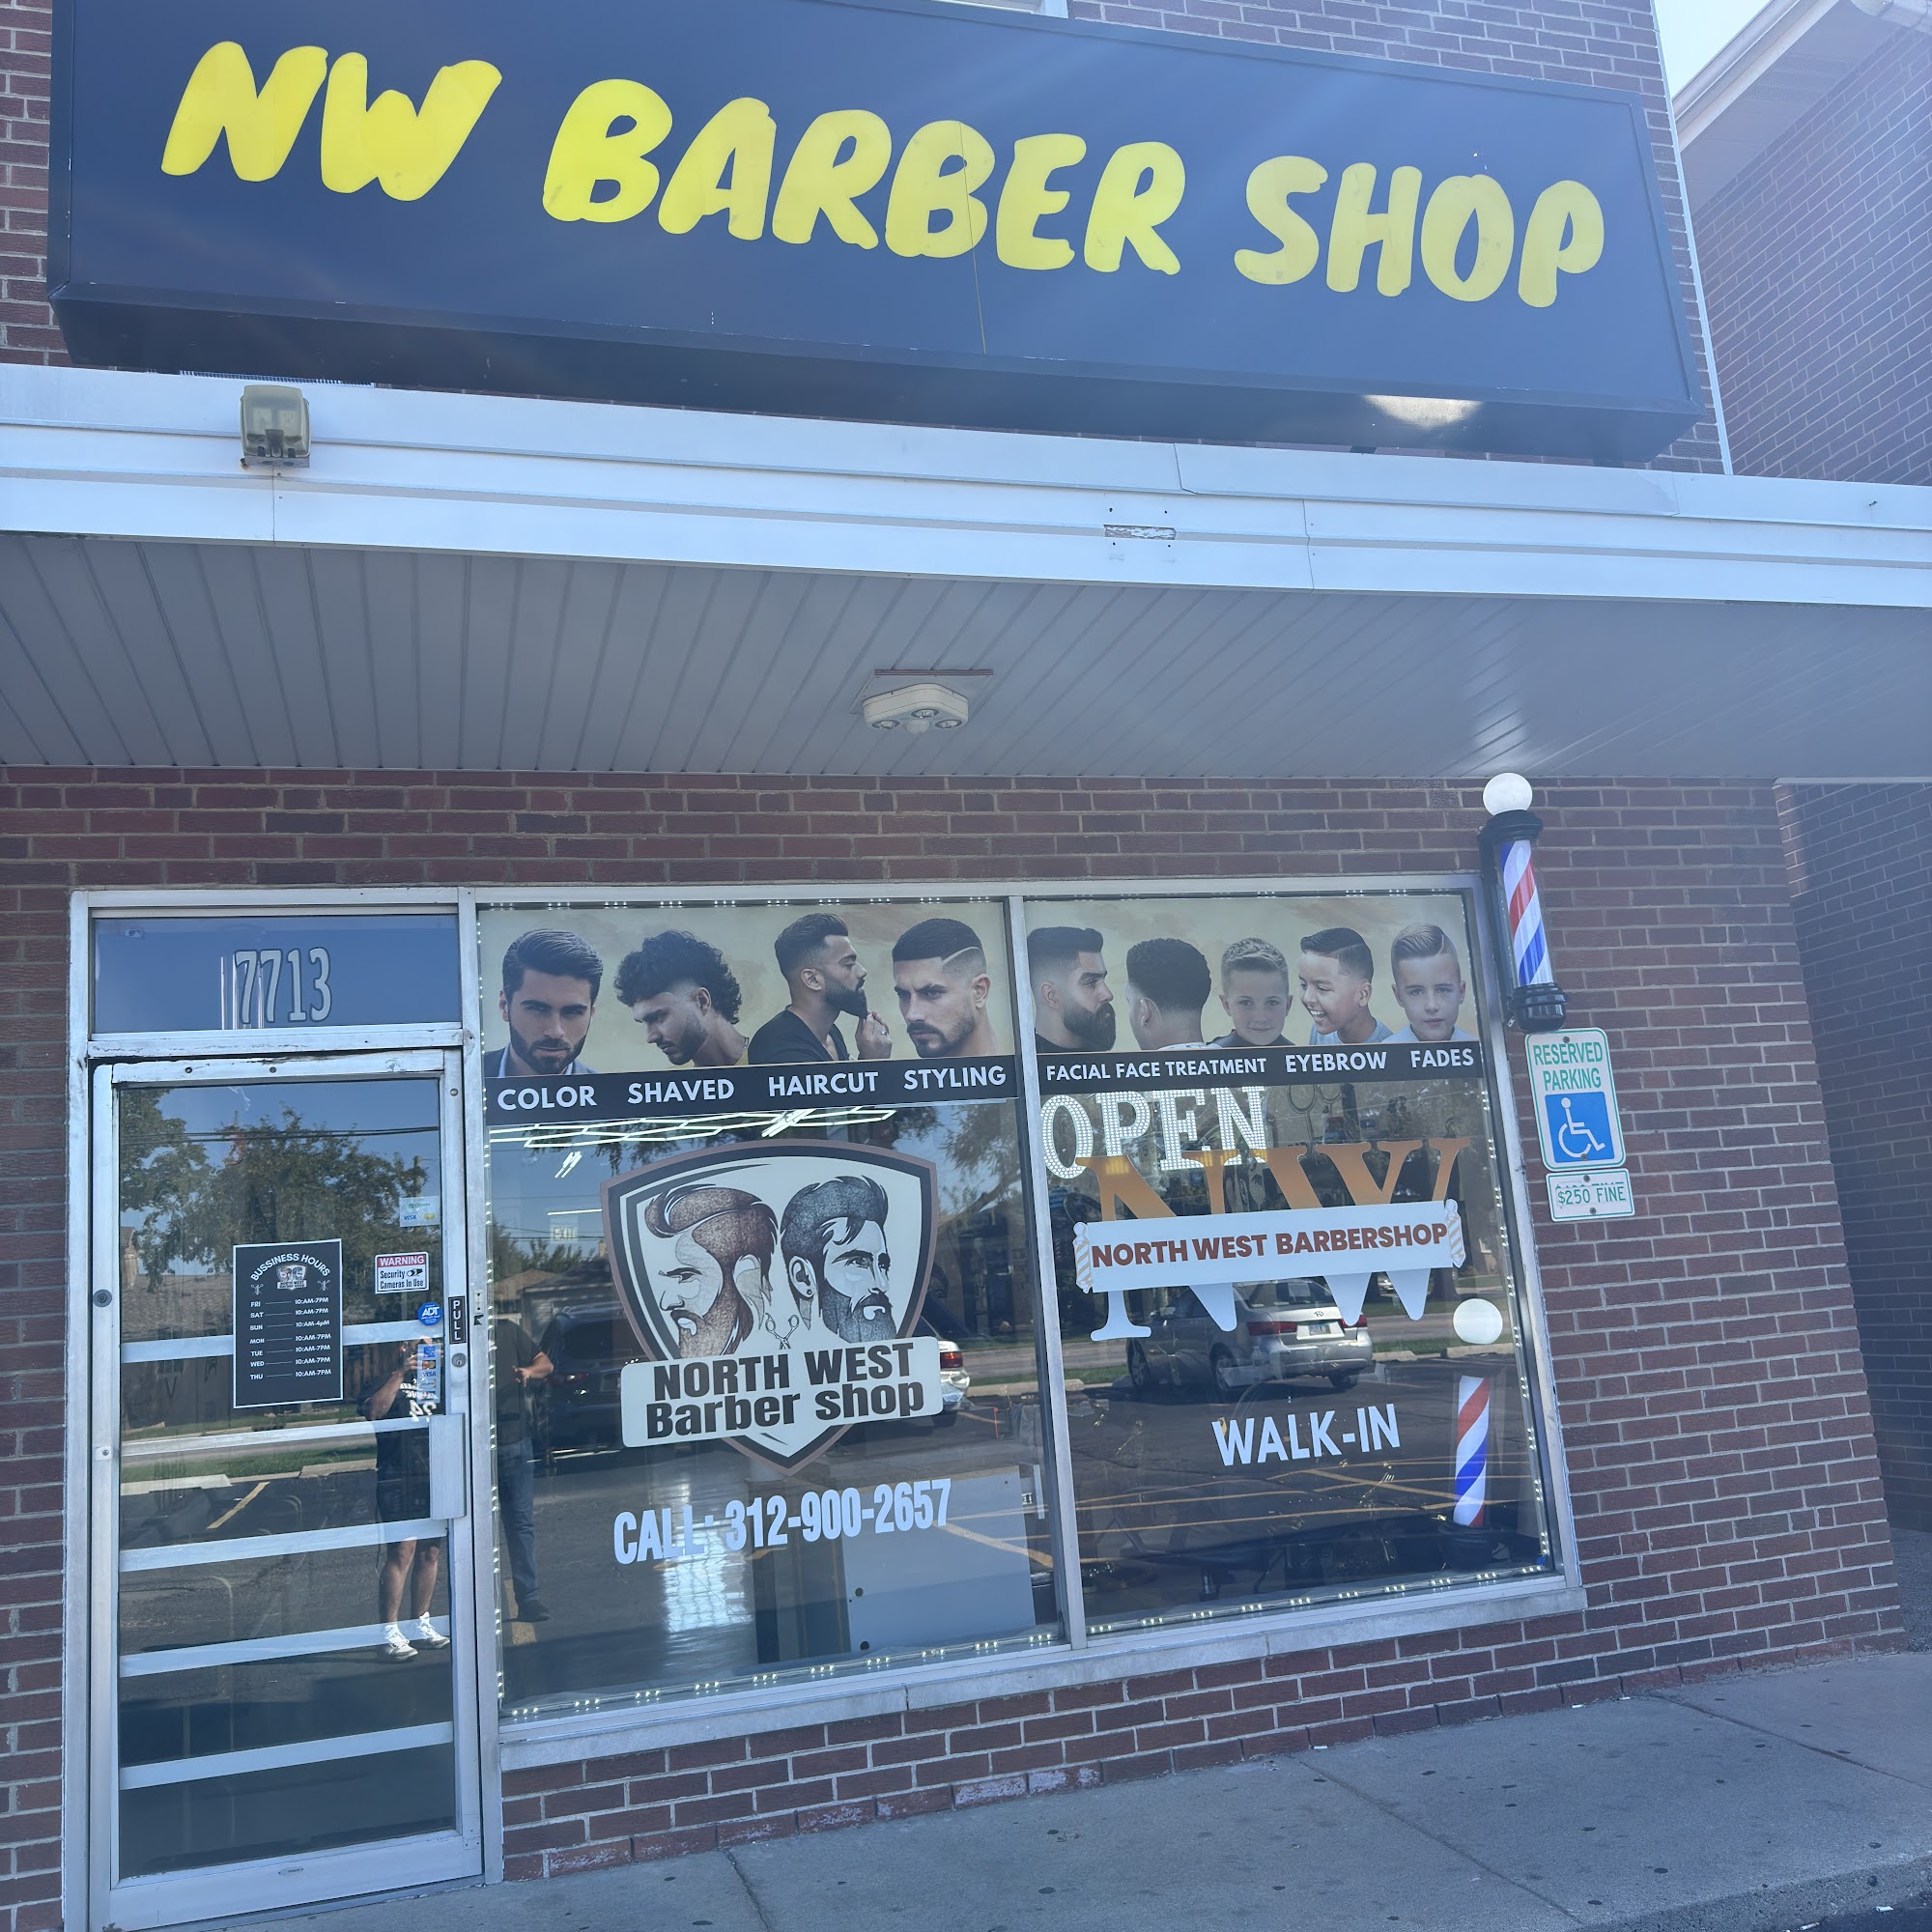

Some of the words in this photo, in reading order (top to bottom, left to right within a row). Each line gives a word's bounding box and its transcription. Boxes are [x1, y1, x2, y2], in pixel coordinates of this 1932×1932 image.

[160, 41, 502, 202] NW
[542, 78, 1186, 275] BARBER
[1234, 156, 1605, 307] SHOP
[235, 946, 332, 1025] 7713
[1046, 1064, 1111, 1081] FACIAL
[1116, 1061, 1160, 1079] FACE
[1165, 1058, 1266, 1077] TREATMENT
[1285, 1051, 1387, 1073] EYEBROW
[1410, 1049, 1474, 1068] FADES
[1533, 1041, 1603, 1065] RESERVED
[497, 1085, 597, 1112] COLOR
[627, 1078, 735, 1105] SHAVED
[768, 1071, 879, 1097] HAIRCUT
[903, 1065, 1007, 1091] STYLING
[1543, 1067, 1602, 1091] PARKING
[1040, 1086, 1267, 1179] OPEN
[1557, 1188, 1591, 1206] $250
[1596, 1186, 1626, 1203] FINE
[380, 1255, 424, 1266] WARNING
[1092, 1239, 1188, 1267] NORTH
[1191, 1235, 1267, 1261] WEST
[1277, 1223, 1448, 1255] BARBERSHOP
[250, 1253, 299, 1281] BUSSINESS
[300, 1254, 330, 1276] HOURS
[380, 1269, 406, 1279] Security
[380, 1280, 405, 1289] Cameras
[413, 1278, 424, 1287] Use
[422, 1306, 440, 1317] ADT
[453, 1299, 462, 1341] PULL
[653, 1353, 790, 1401] NORTH
[804, 1342, 915, 1385] WEST
[646, 1392, 801, 1439] Barber
[814, 1380, 924, 1421] shop
[1211, 1403, 1401, 1466] WALK-IN
[724, 1478, 952, 1551] 312-900-2657
